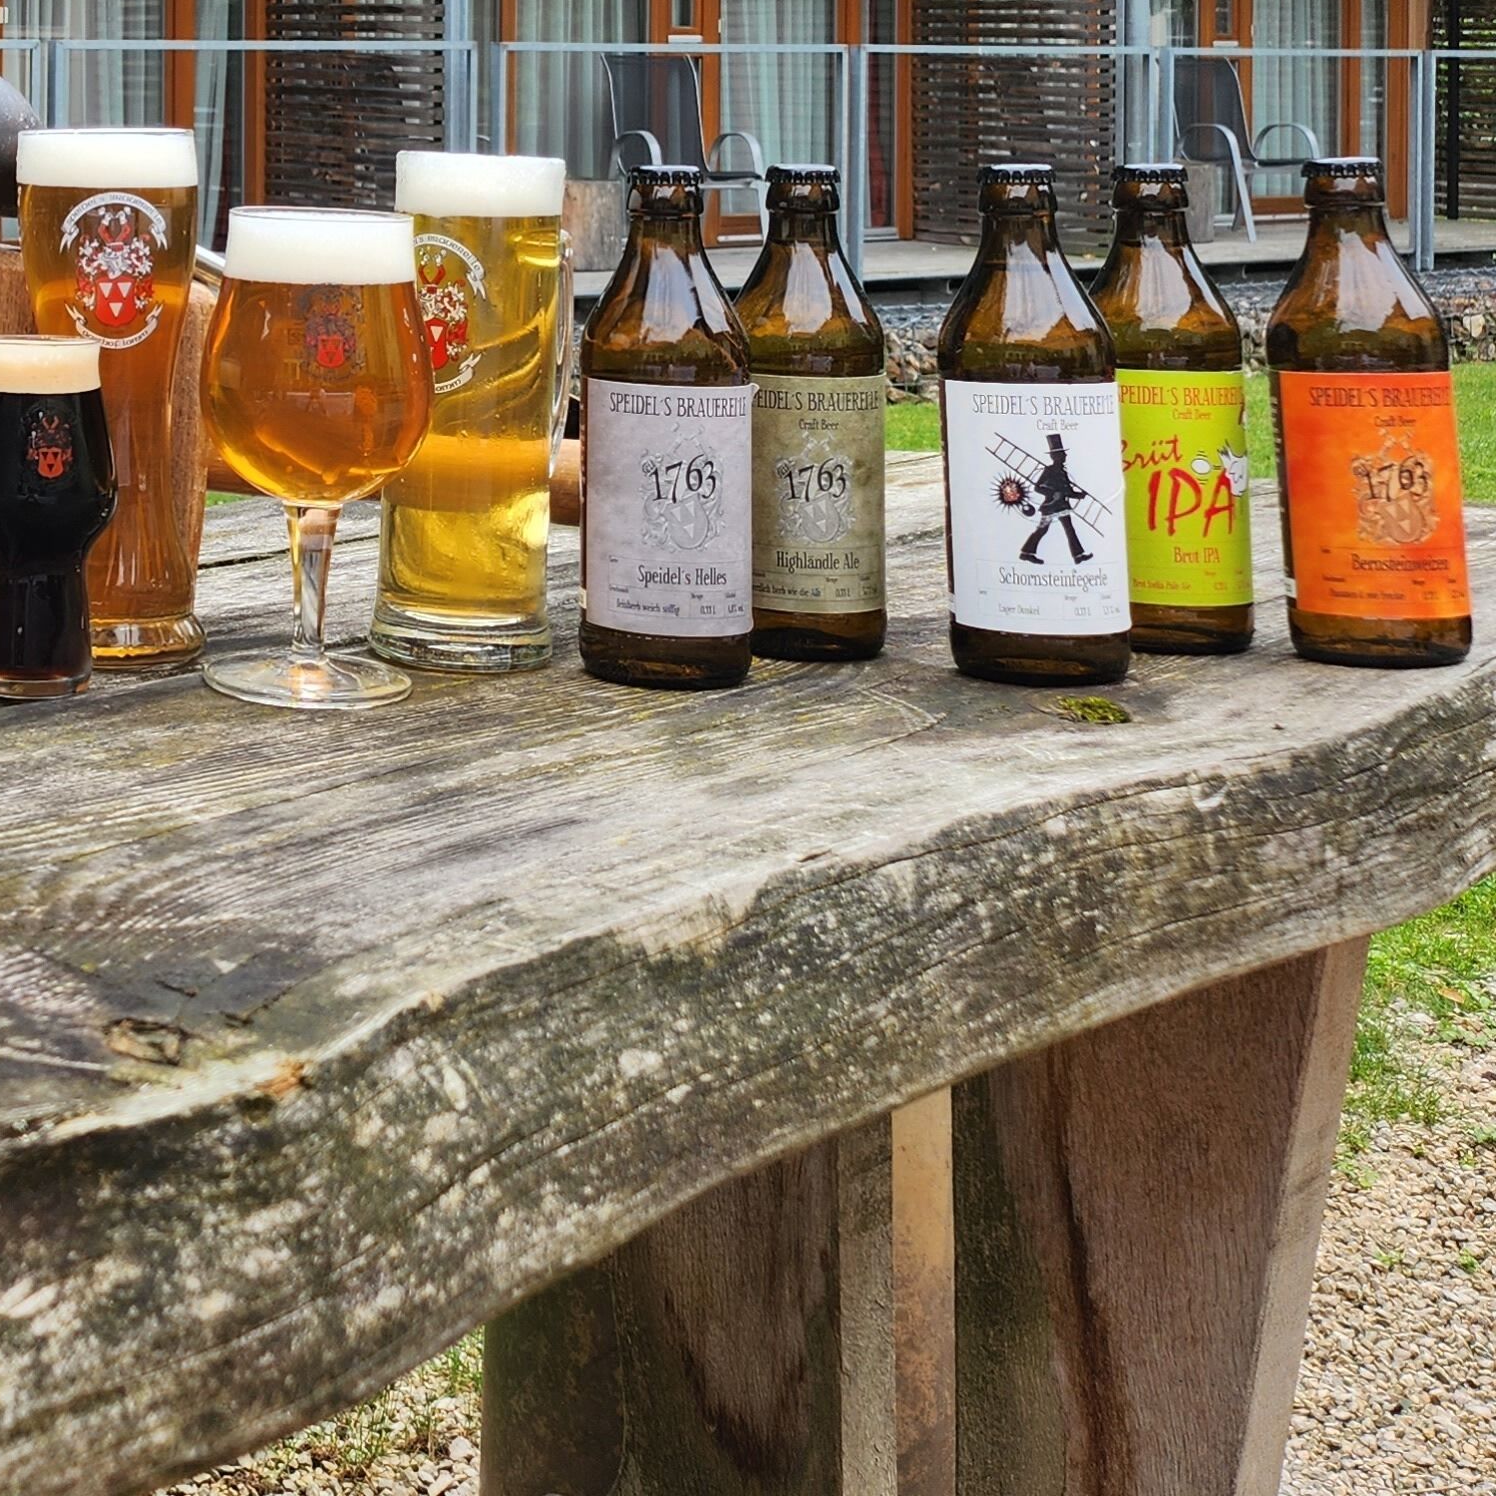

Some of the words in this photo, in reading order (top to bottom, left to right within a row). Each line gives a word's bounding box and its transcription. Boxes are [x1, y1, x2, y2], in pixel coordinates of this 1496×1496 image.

[1119, 385, 1178, 405] PEIDEL'S
[649, 454, 716, 504] 1763
[784, 458, 846, 502] 1763
[1363, 456, 1428, 502] 1763
[1148, 468, 1235, 537] IPA
[776, 551, 840, 574] Highländle
[844, 552, 860, 569] Ale
[1174, 546, 1199, 563] Brut
[1204, 547, 1220, 563] IPA
[638, 565, 691, 588] Speidel's
[695, 567, 727, 585] Helles
[999, 566, 1108, 592] Schornsteinfegerle
